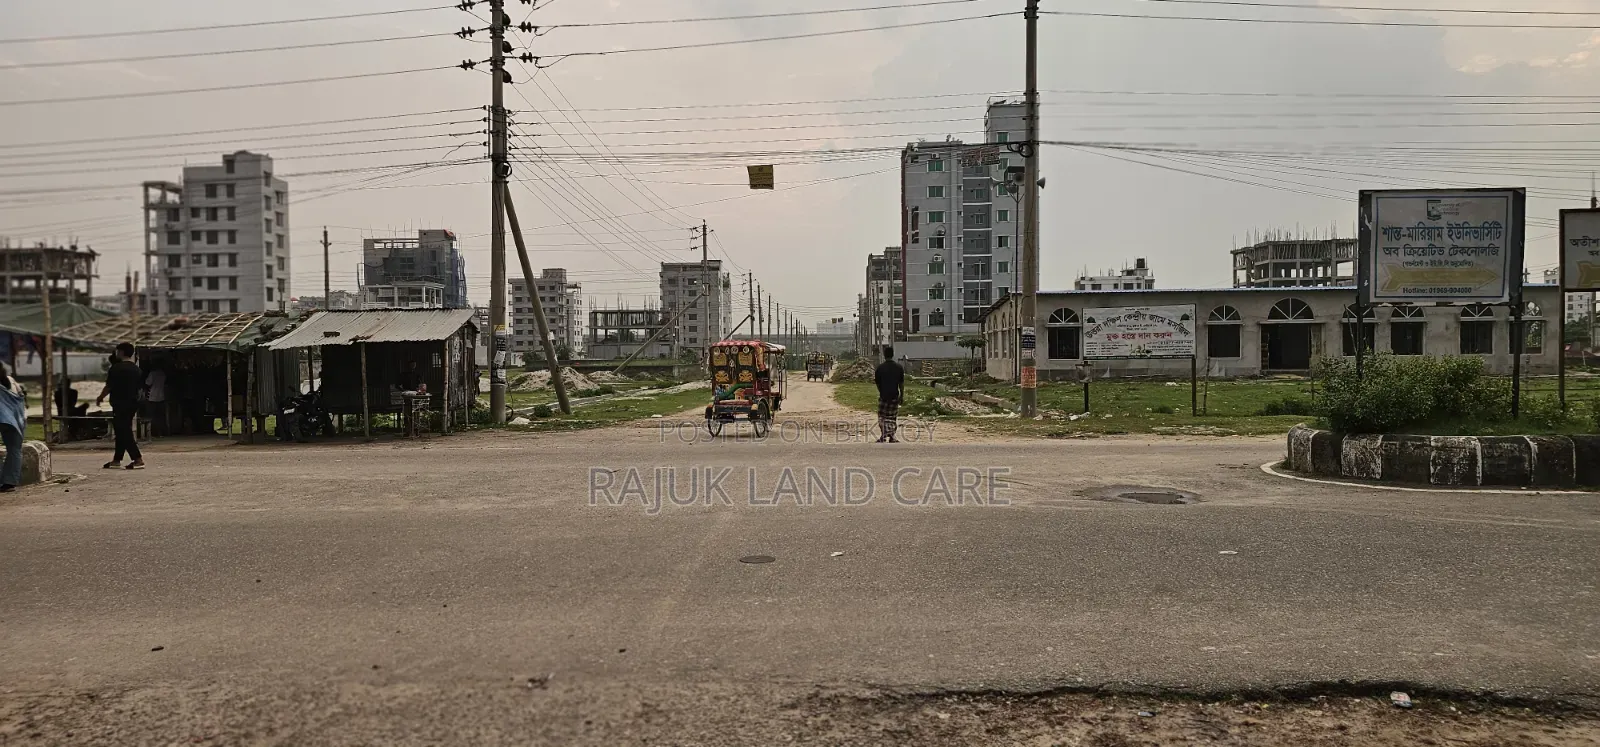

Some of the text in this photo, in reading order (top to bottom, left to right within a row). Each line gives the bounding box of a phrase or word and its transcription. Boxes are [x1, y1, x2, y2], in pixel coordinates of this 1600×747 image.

[1381, 221, 1503, 242] শান্ত-মারিয়াম ইউনিভার্সিটি
[1382, 243, 1500, 257] অব ক্রিয়েটিভ টেকনোলজি
[1149, 314, 1167, 324] জামে
[1138, 332, 1151, 340] দান
